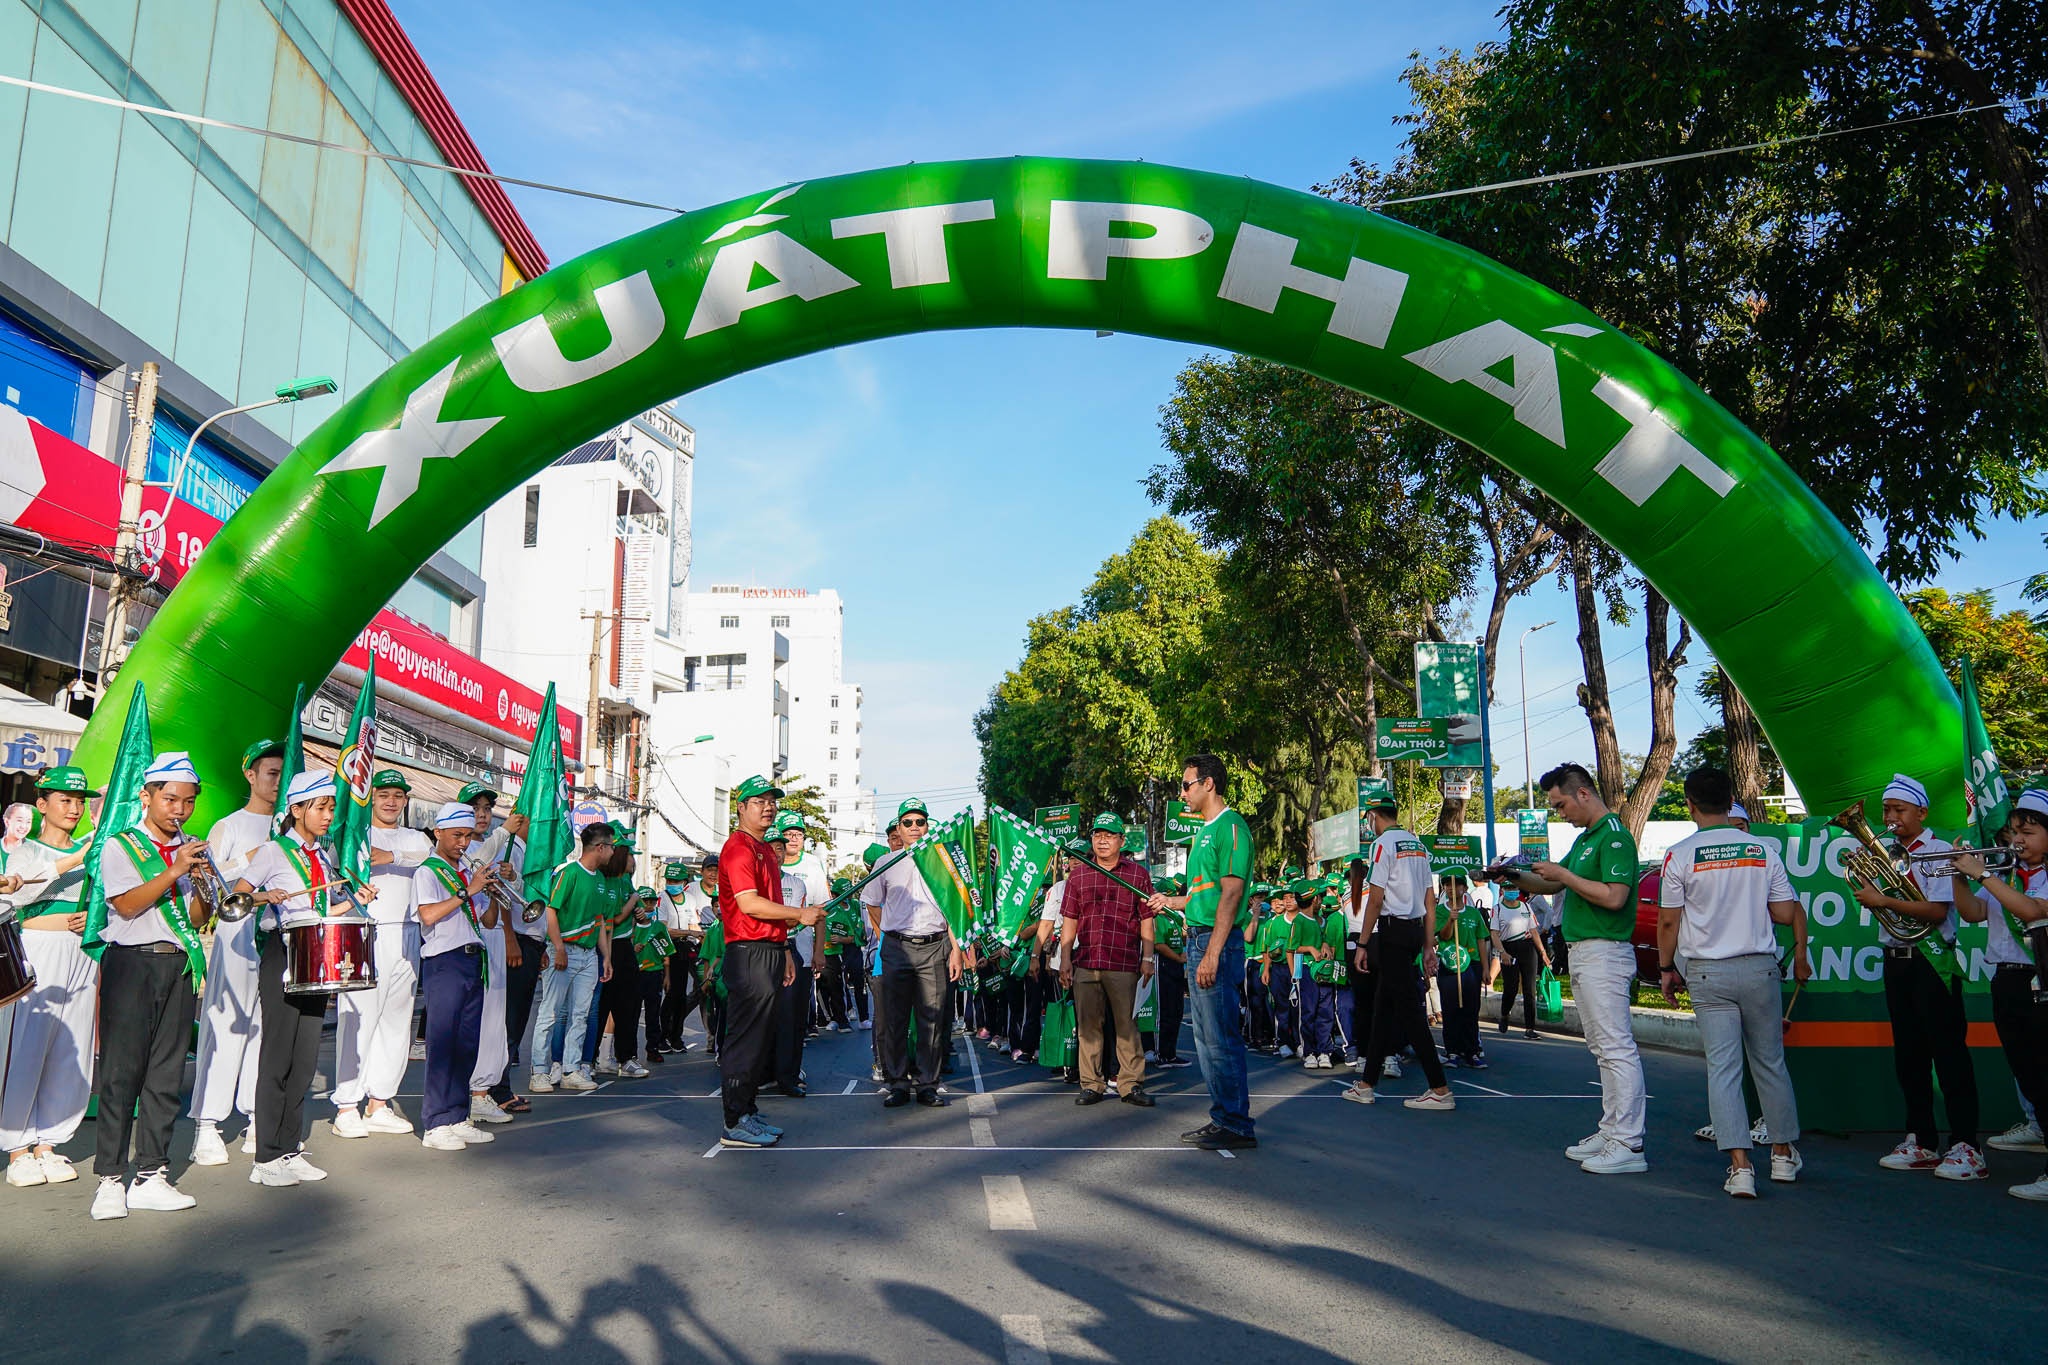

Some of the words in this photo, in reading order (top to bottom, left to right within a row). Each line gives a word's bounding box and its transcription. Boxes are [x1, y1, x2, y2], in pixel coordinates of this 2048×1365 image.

[315, 183, 995, 531] XUẤT
[1047, 199, 1737, 508] PHÁT
[772, 588, 806, 598] MINH
[1391, 740, 1406, 748] AN
[1409, 738, 1436, 748] THỚI
[1439, 740, 1446, 748] 2
[1072, 825, 1077, 833] 2
[1177, 824, 1190, 833] AN
[1433, 856, 1447, 864] AN
[1449, 854, 1473, 864] THỚI
[1475, 857, 1480, 865] 2
[995, 868, 1014, 912] NGÀY
[1010, 840, 1027, 871] HỘI
[1012, 886, 1026, 906] ĐI
[1021, 861, 1039, 889] BỘ
